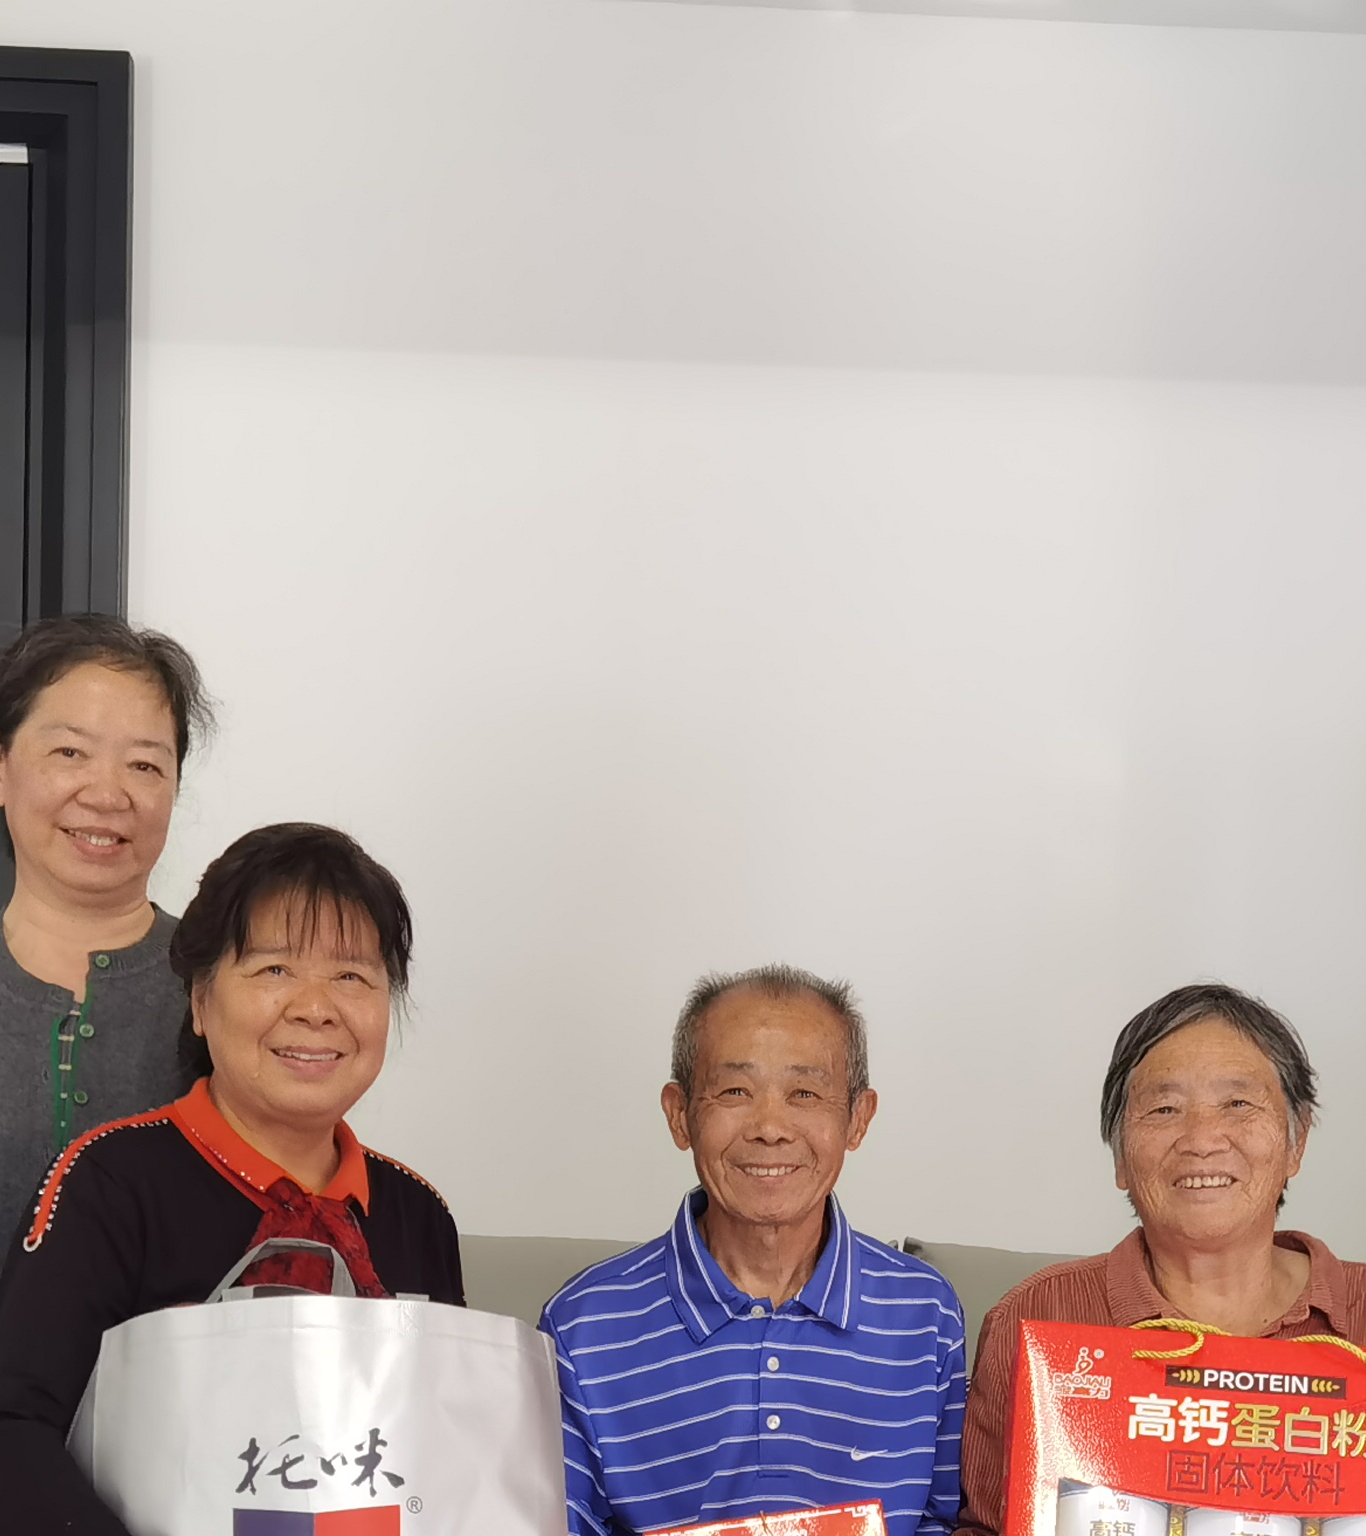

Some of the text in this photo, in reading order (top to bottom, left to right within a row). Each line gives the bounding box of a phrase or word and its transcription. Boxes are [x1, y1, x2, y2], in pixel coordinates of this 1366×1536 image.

[1203, 1369, 1309, 1394] PROTEIN
[1166, 1449, 1346, 1506] 固体饮料
